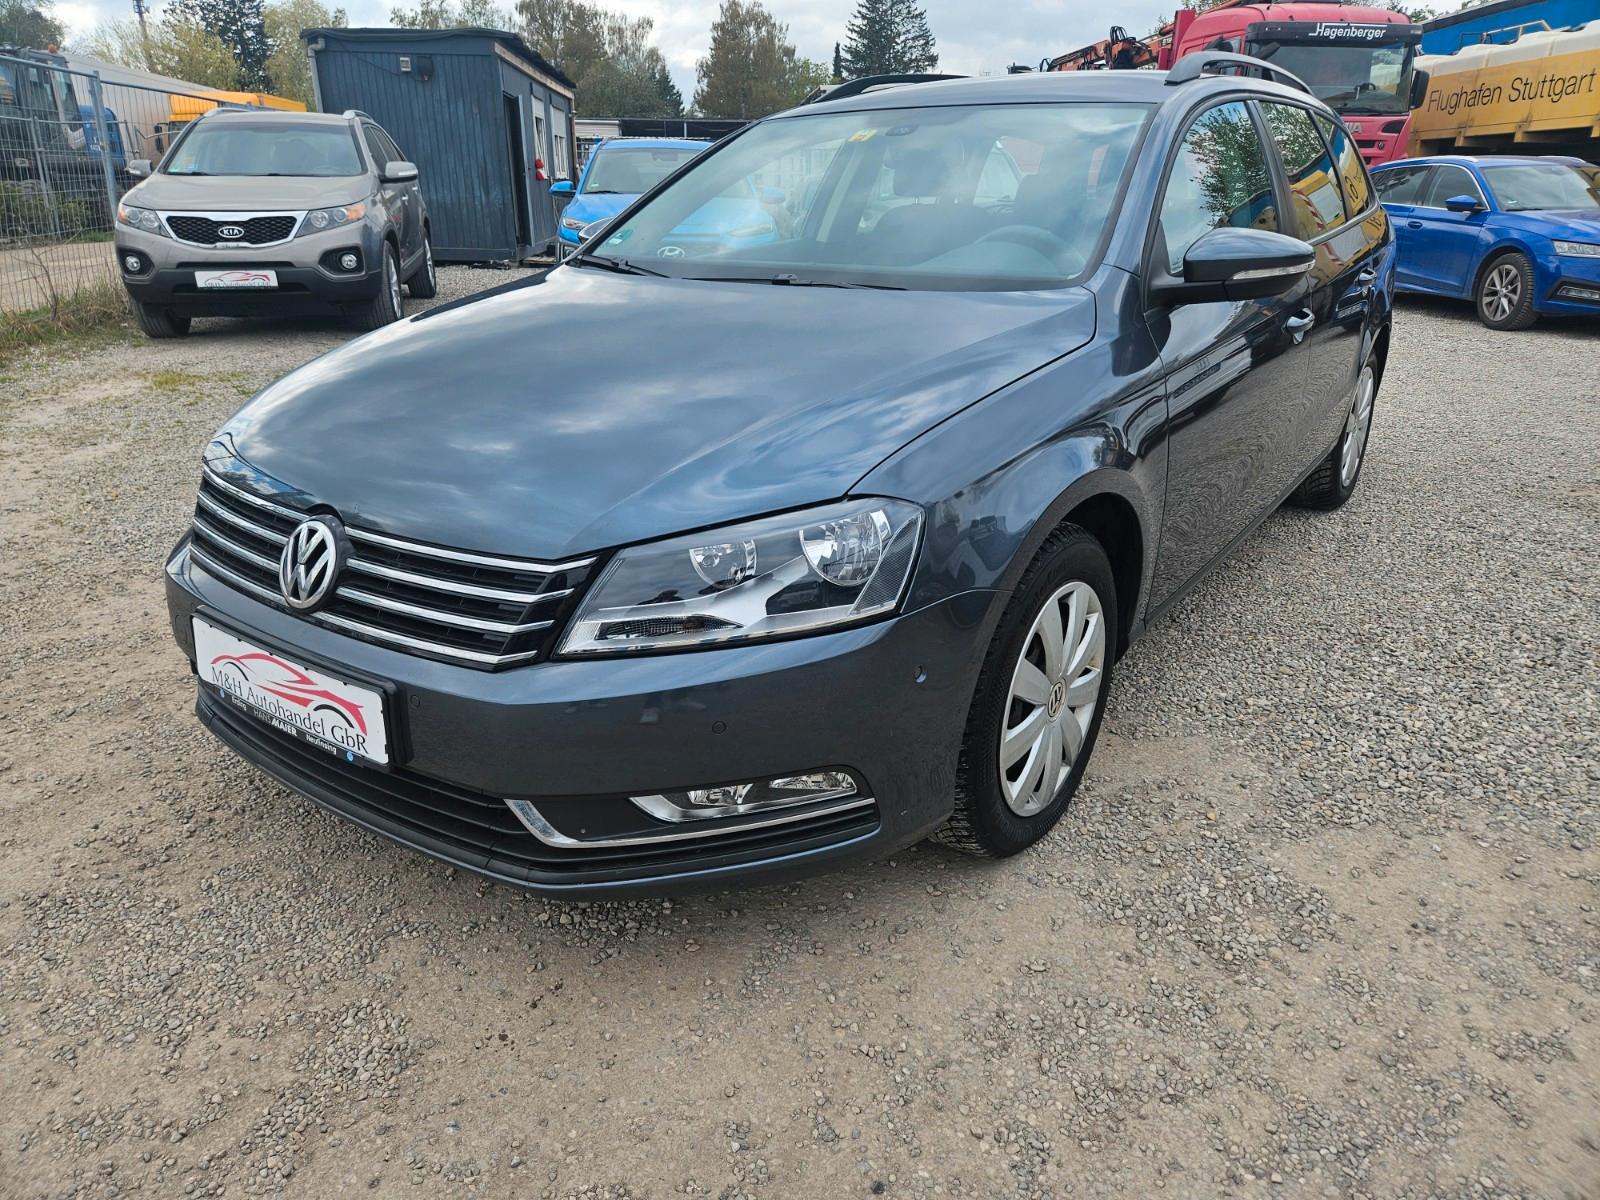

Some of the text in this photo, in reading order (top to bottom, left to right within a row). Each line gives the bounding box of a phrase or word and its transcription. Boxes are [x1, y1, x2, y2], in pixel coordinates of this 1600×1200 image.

[1309, 23, 1387, 40] Hagenberger
[1427, 68, 1596, 115] Flughafen Stuttgart
[223, 228, 239, 236] KIA
[211, 666, 369, 754] M&H Autohandel GbR
